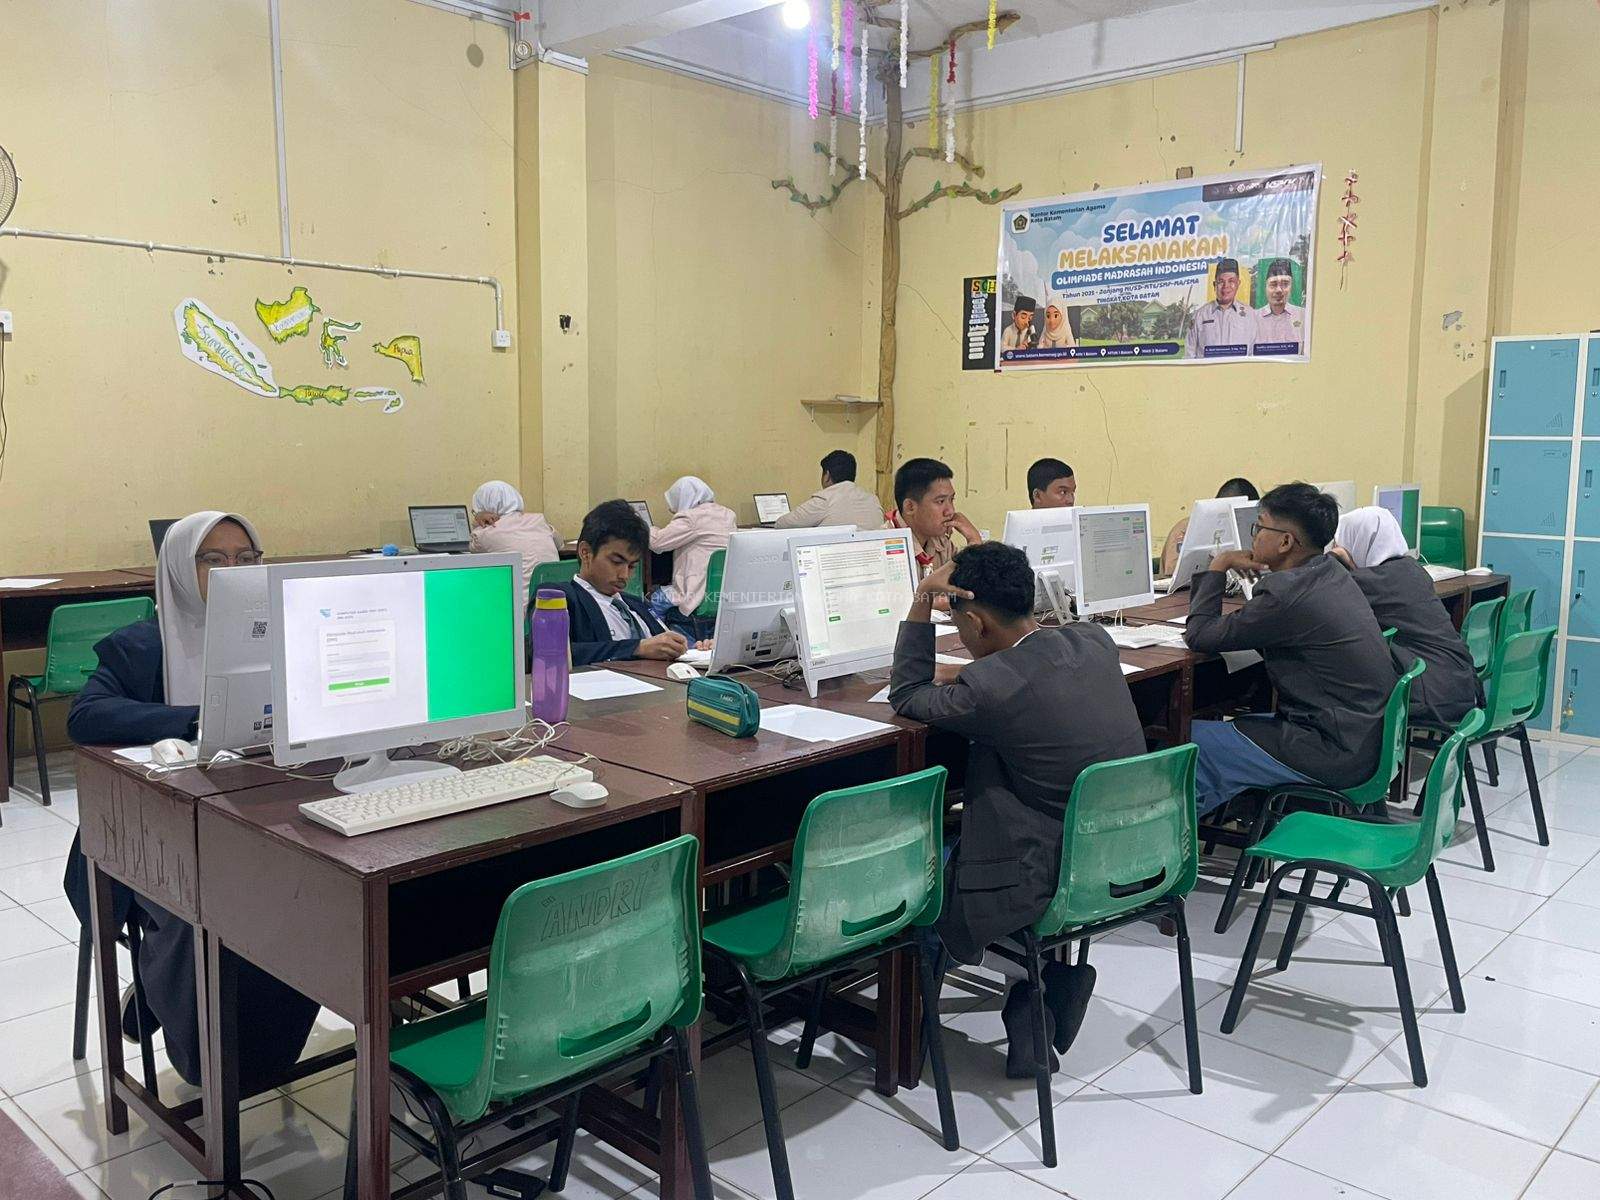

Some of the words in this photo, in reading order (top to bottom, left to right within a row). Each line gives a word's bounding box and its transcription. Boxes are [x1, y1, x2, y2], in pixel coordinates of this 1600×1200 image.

[1050, 207, 1085, 216] Kementerian
[1086, 204, 1106, 212] Agama
[1103, 215, 1200, 243] SELAMAT
[1059, 235, 1228, 268] MELAKSANAKAN
[1056, 272, 1103, 285] OLIMPIADE
[1104, 268, 1153, 280] MADRASAH
[1155, 261, 1207, 274] INDONESIA
[1062, 291, 1081, 299] Tahun
[1121, 294, 1139, 302] KOTA
